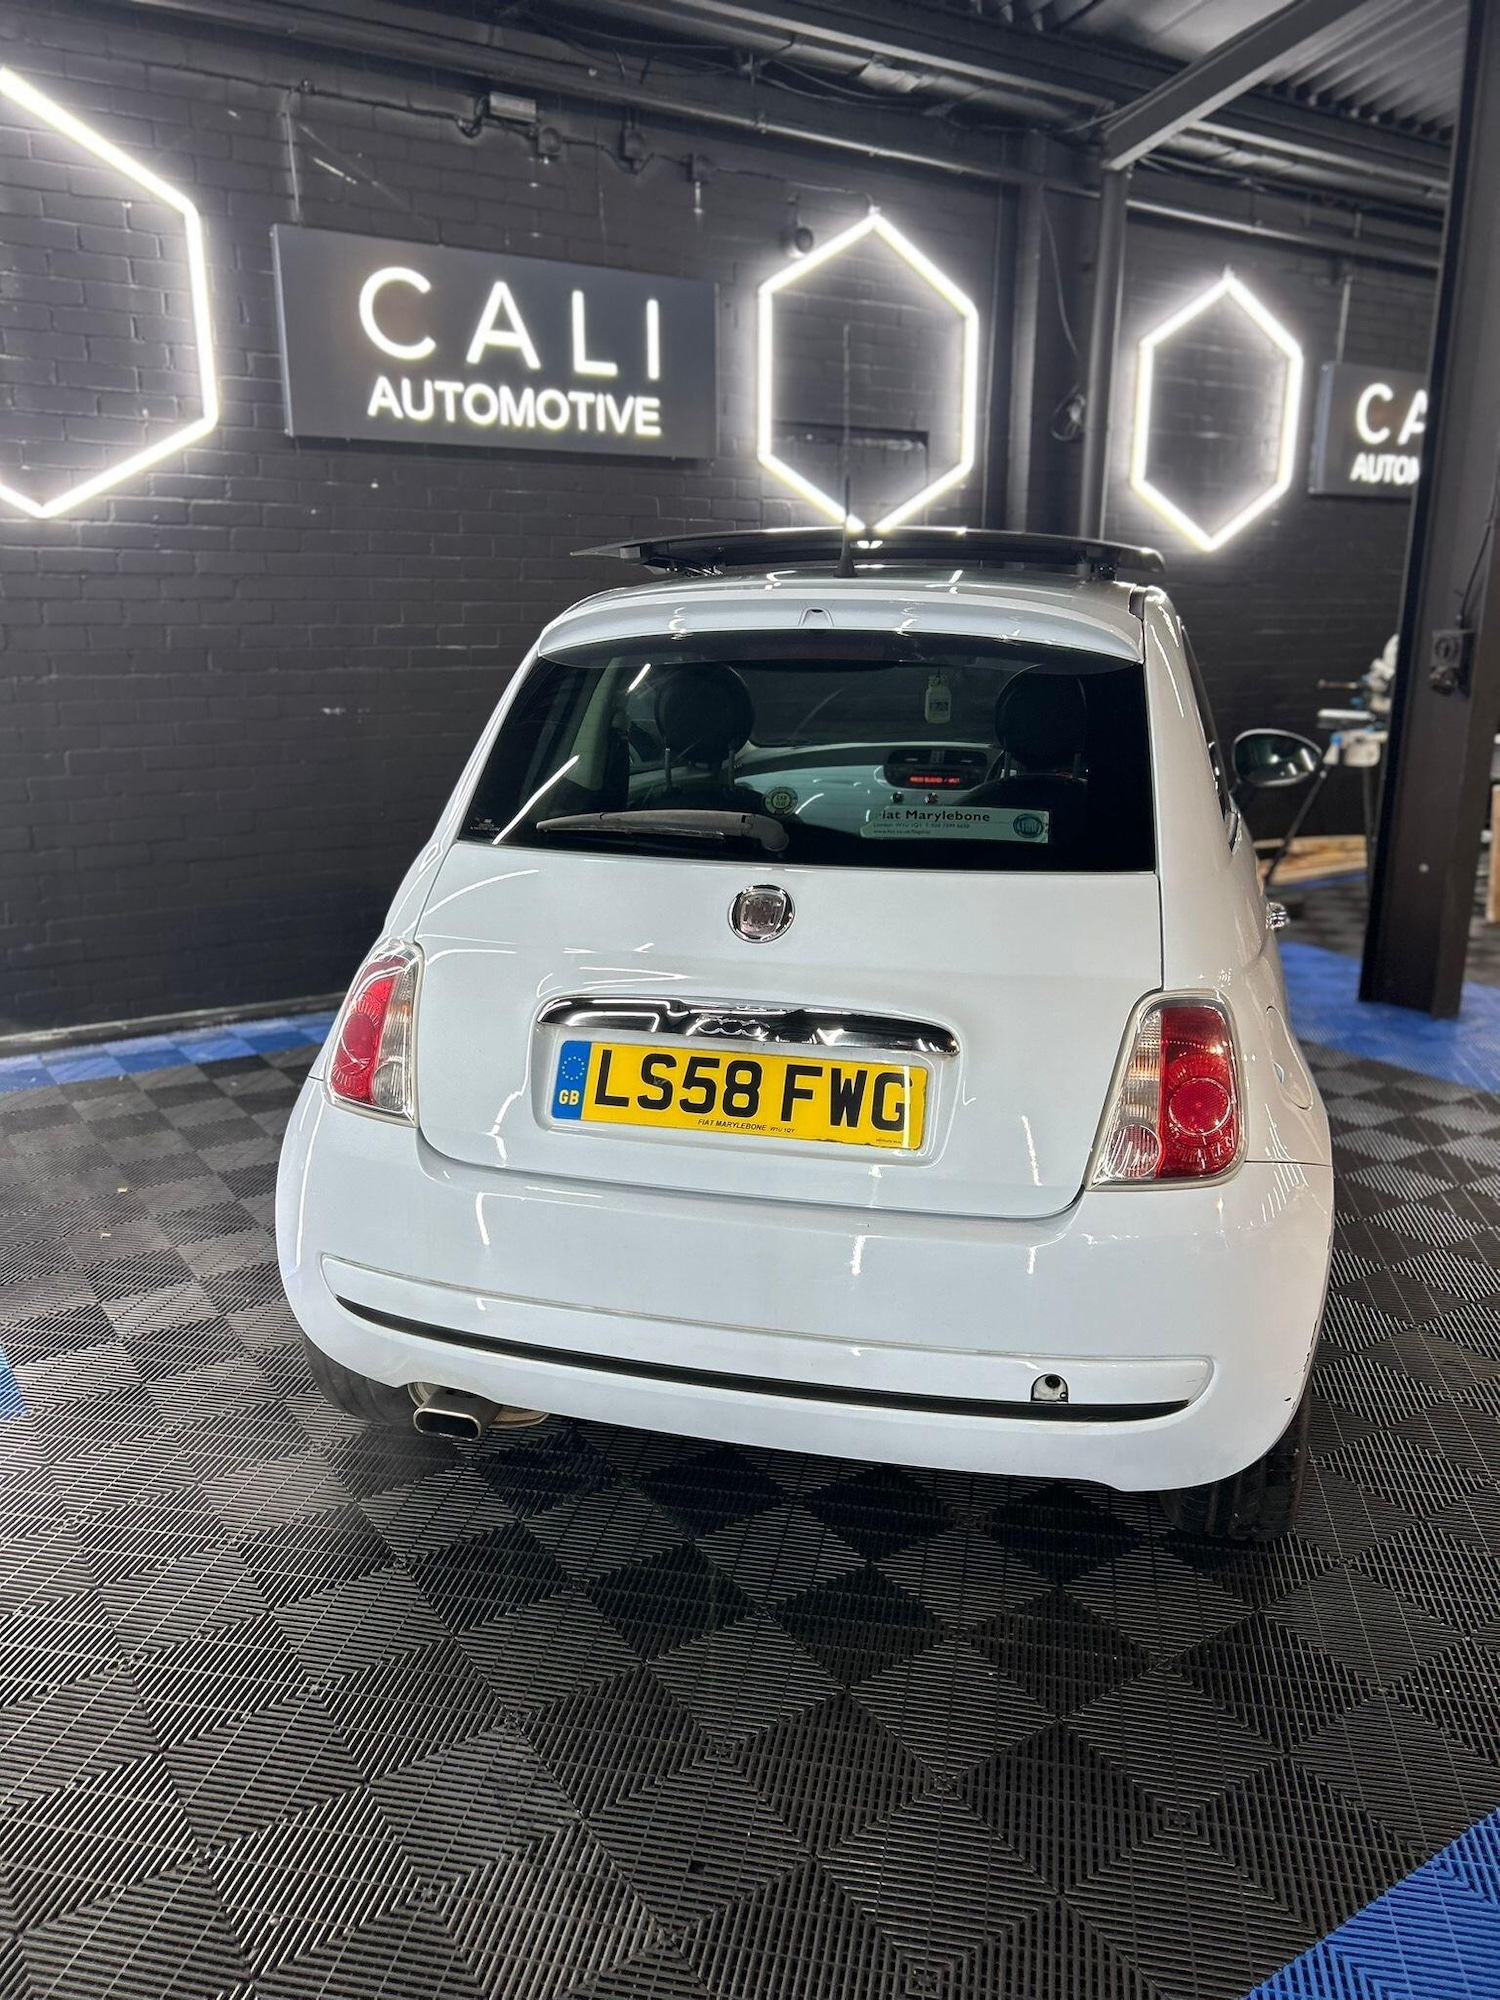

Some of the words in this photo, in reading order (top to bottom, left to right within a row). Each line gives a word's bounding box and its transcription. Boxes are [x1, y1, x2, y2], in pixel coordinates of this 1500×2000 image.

[358, 265, 660, 380] CALI
[367, 375, 662, 436] AUTOMOTIVE
[878, 810, 901, 820] iat
[905, 810, 990, 822] Marylebone
[559, 1089, 580, 1105] GB
[594, 1049, 763, 1118] LS58
[780, 1063, 913, 1132] FWG
[697, 1118, 714, 1126] FIAT
[715, 1120, 767, 1131] MARYLEBONE
